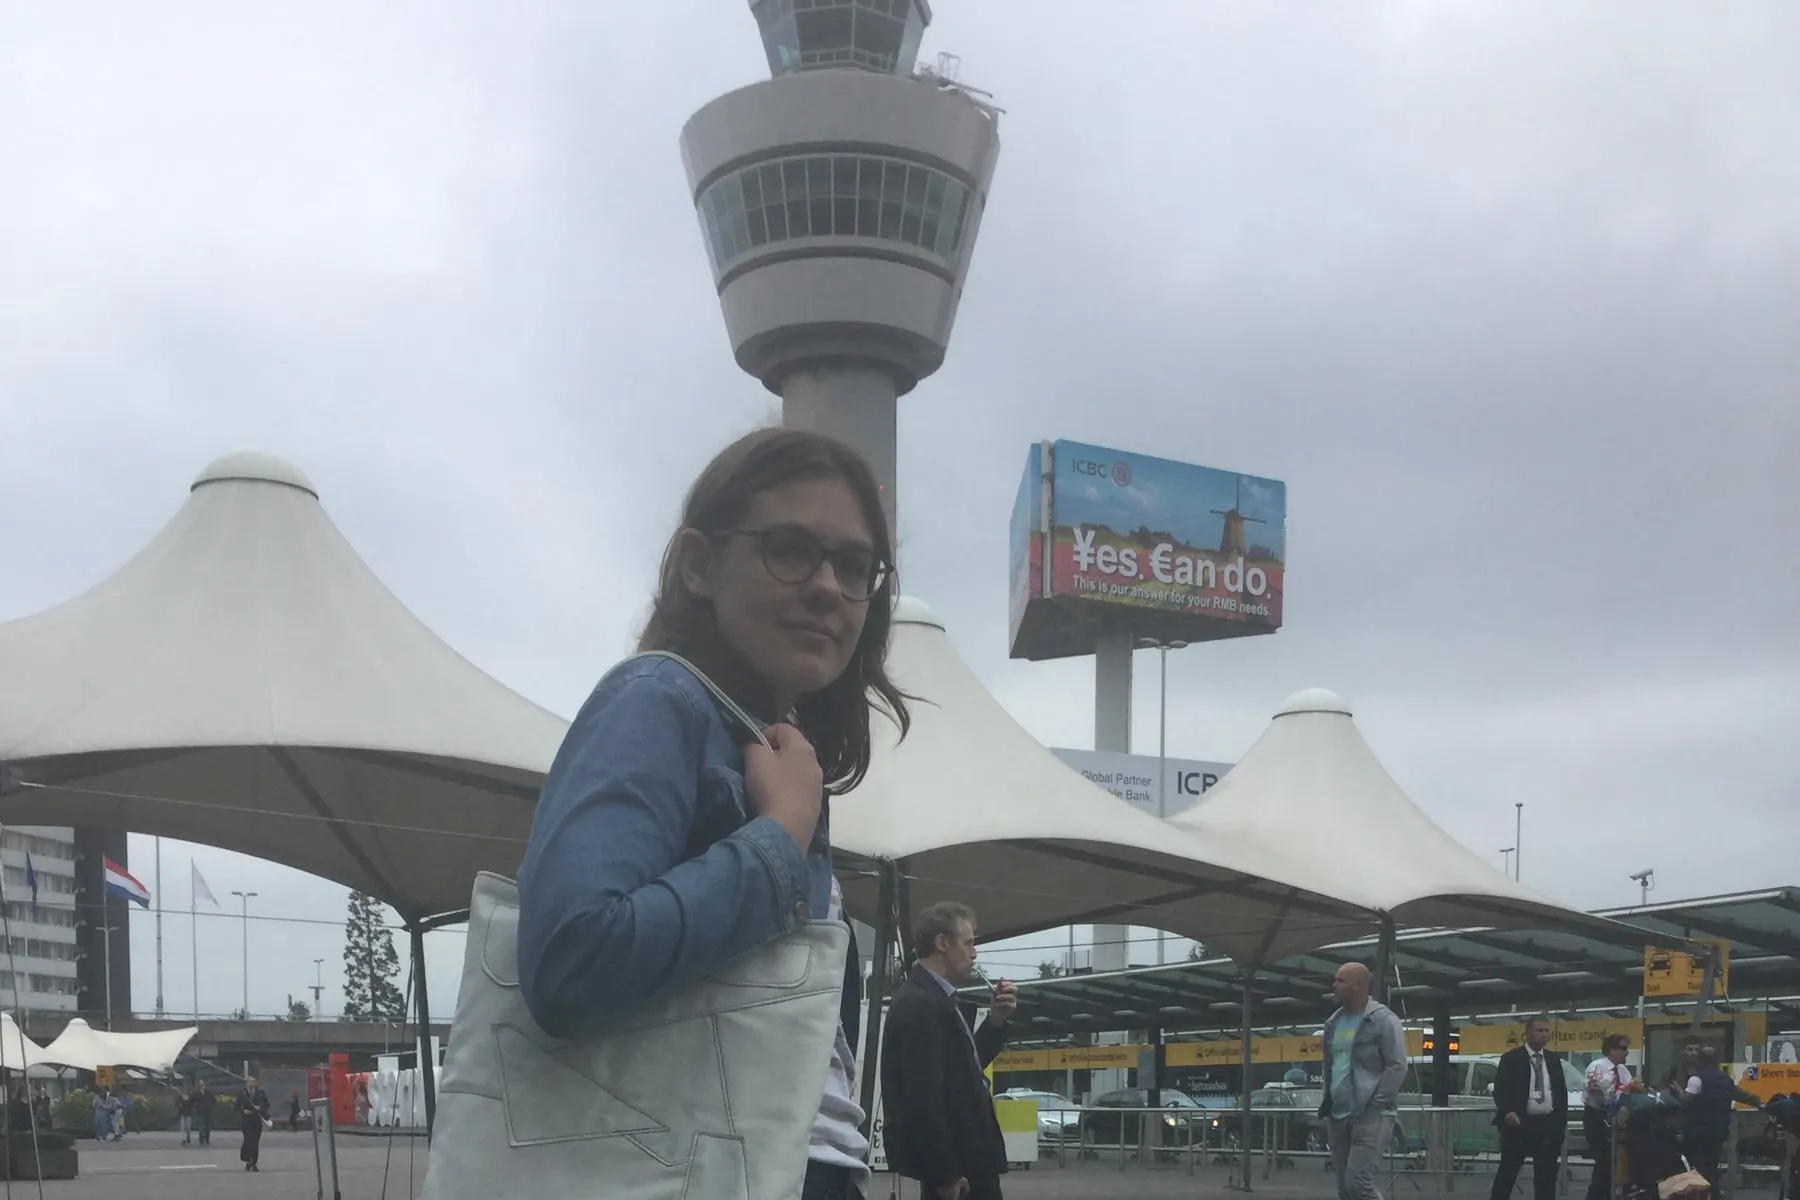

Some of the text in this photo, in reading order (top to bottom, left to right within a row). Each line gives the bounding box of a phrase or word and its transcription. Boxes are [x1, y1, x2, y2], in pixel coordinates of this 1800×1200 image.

[1072, 458, 1107, 478] ICBC
[1223, 556, 1272, 599] do.
[1073, 574, 1272, 616] This is our answer for your RMB needs.
[1081, 769, 1152, 787] Global Partner
[1177, 771, 1218, 795] ICB
[1126, 789, 1151, 801] Bank
